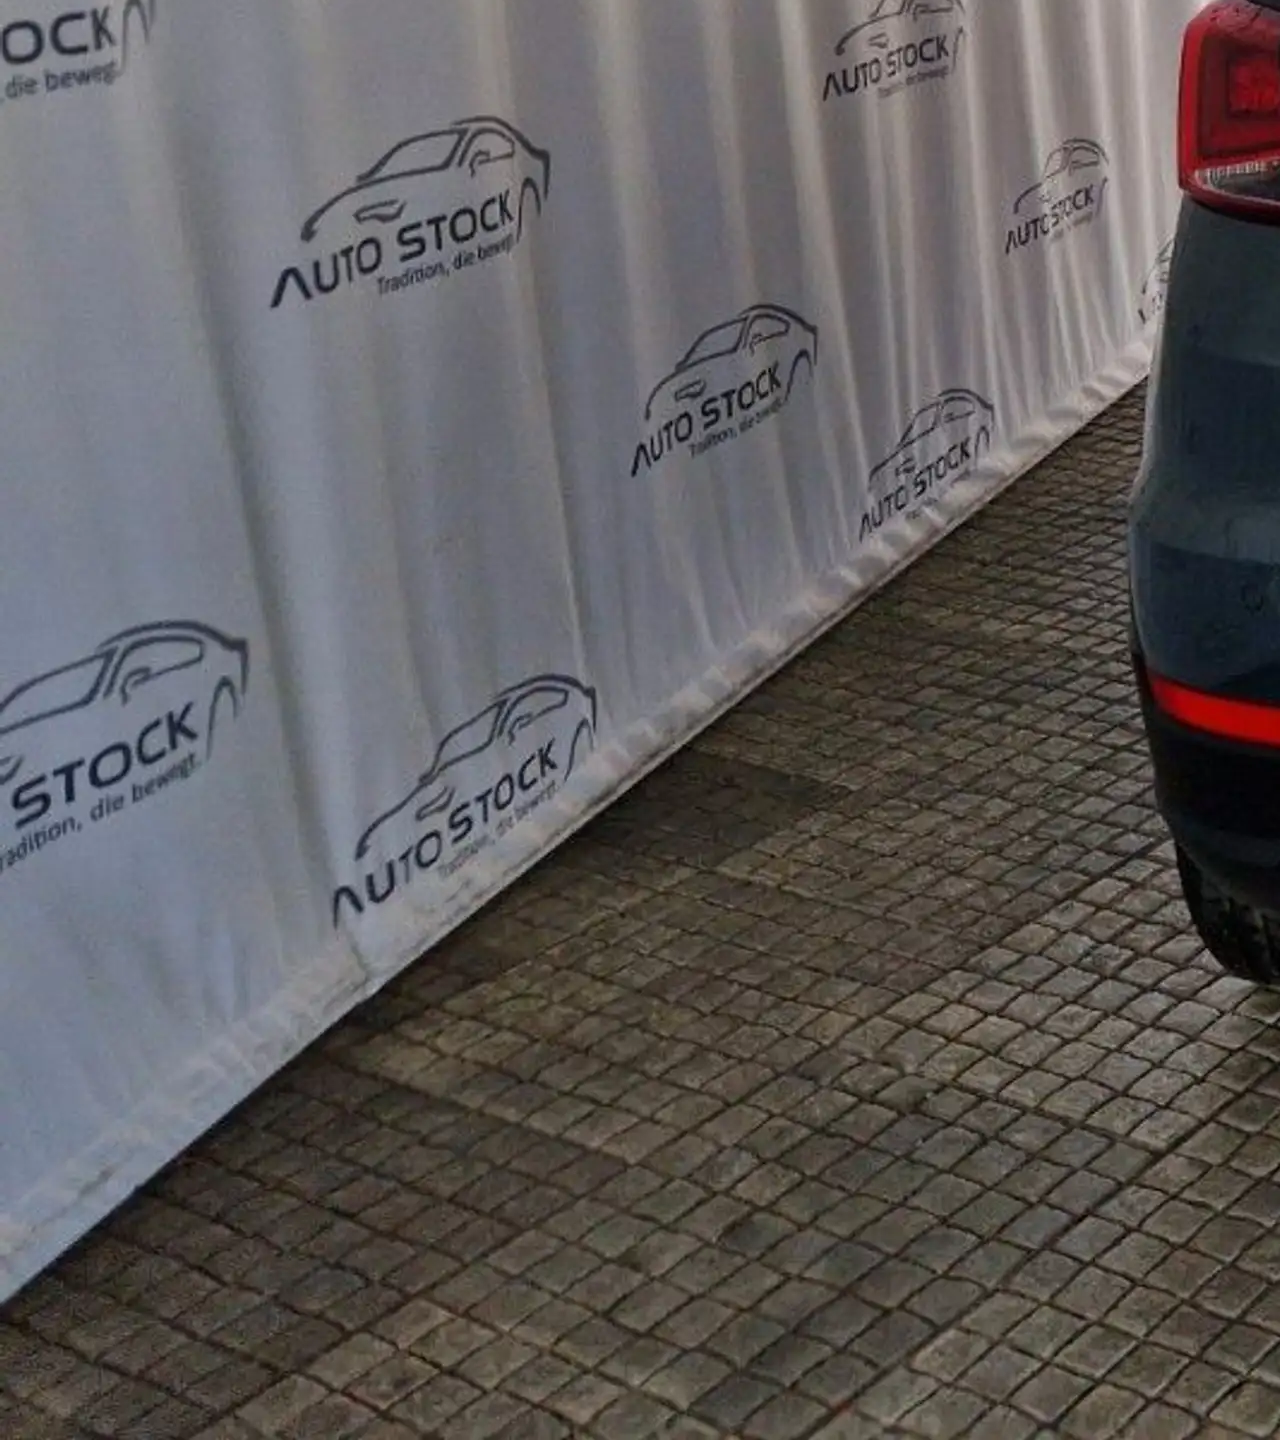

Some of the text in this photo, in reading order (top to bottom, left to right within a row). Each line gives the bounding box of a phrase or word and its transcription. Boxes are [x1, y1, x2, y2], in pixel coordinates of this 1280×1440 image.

[822, 57, 881, 102] AUTO
[887, 34, 949, 78] STOCK
[270, 188, 514, 308] AUTO STOCK
[631, 360, 781, 478] AUTO STOCK
[859, 485, 908, 544] AUTO
[914, 436, 971, 499] STOCK
[12, 700, 198, 829] STOCK
[90, 793, 125, 822] die
[333, 736, 558, 930] AUTO STOCK
